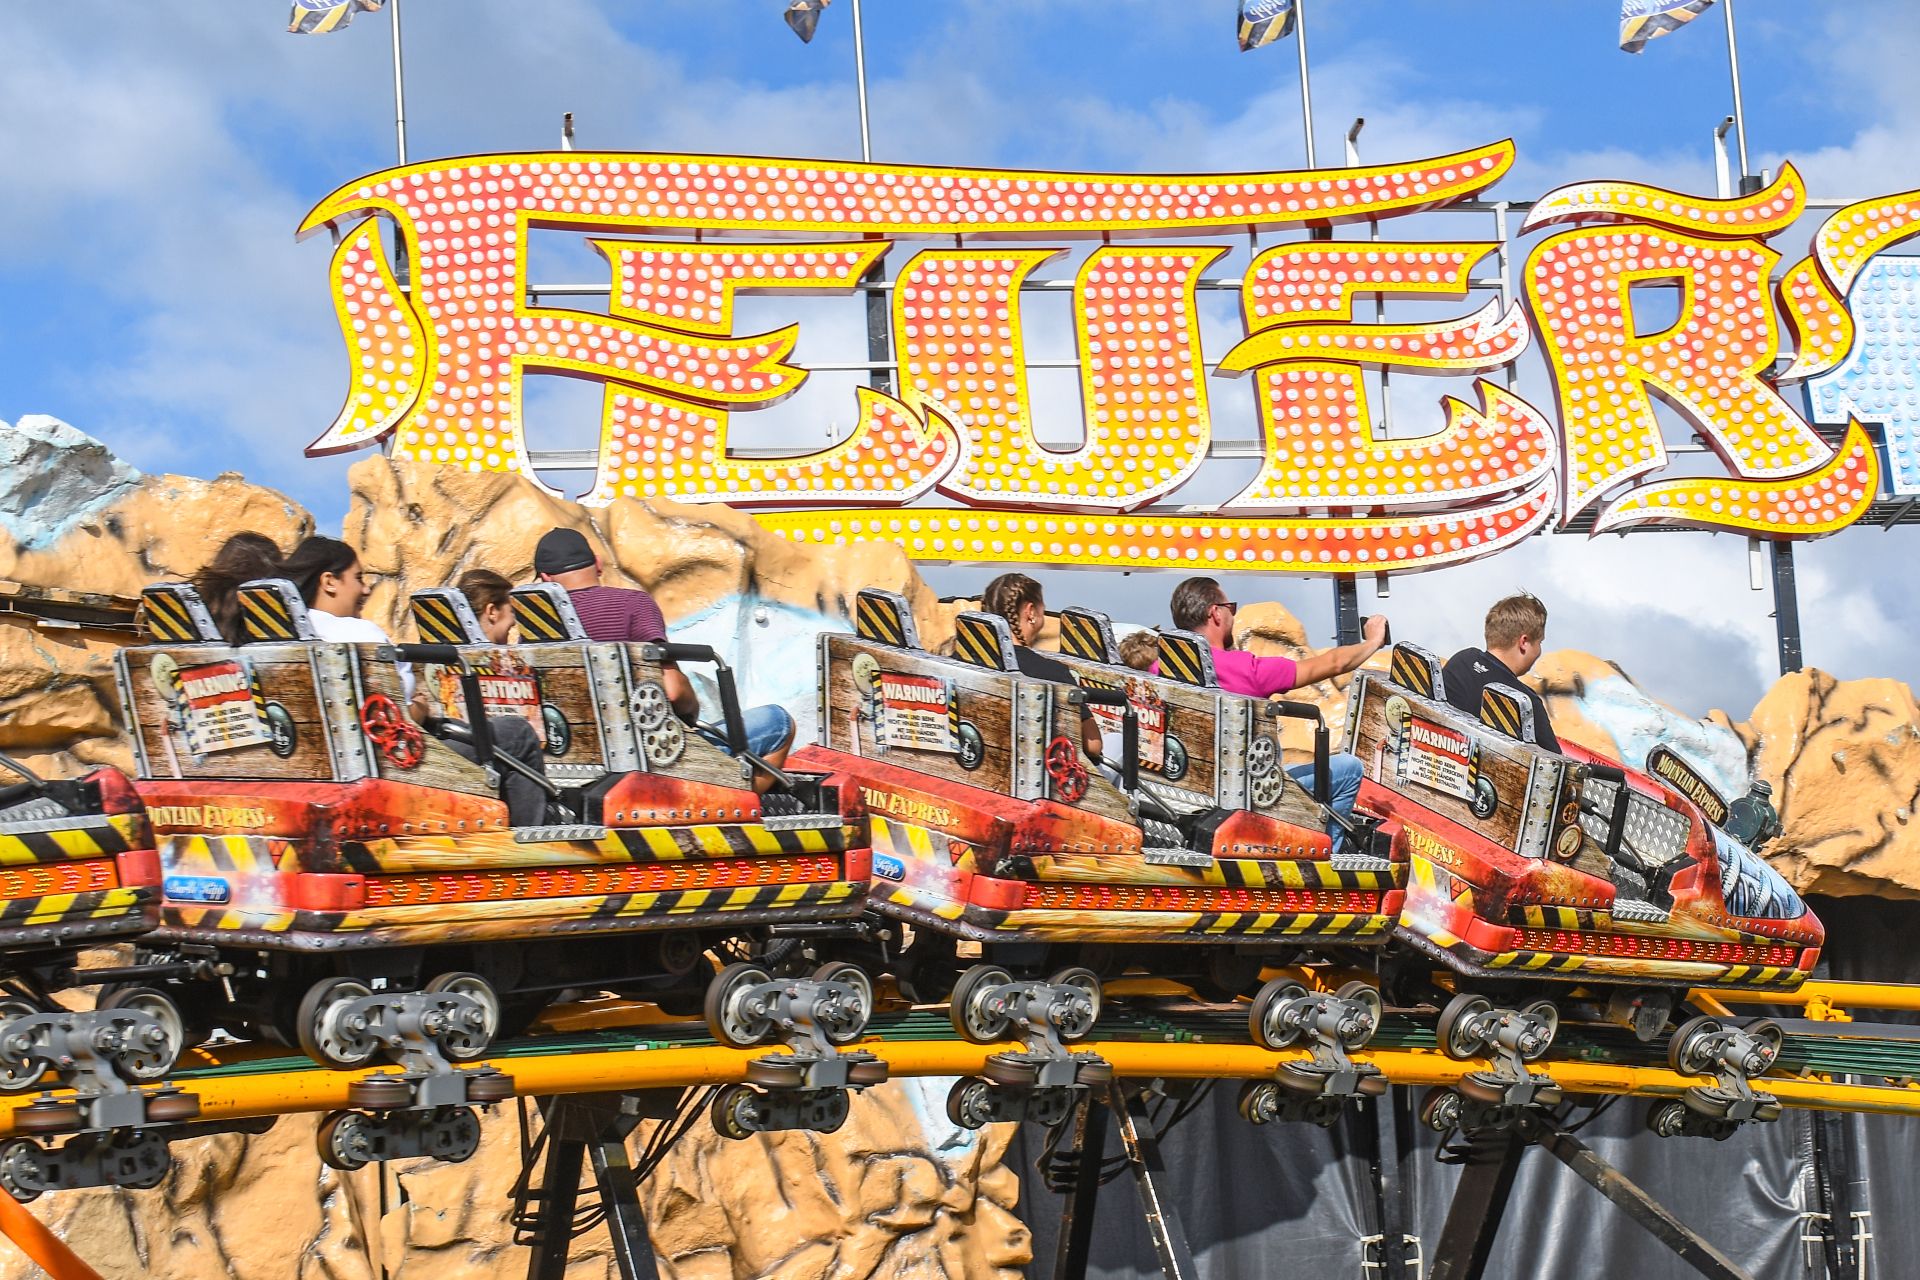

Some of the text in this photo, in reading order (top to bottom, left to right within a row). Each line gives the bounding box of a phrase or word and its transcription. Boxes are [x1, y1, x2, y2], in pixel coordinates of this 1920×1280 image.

[297, 137, 1880, 575] FEUER
[183, 671, 248, 700] WARNING
[480, 680, 535, 700] ENTION
[881, 682, 947, 705] WARNING
[1410, 725, 1469, 758] WARNING
[1656, 754, 1697, 794] MOUNTAIN
[1690, 781, 1725, 822] EXPRESS
[203, 804, 266, 829] EXPRESS
[887, 792, 951, 826] EXPRESS
